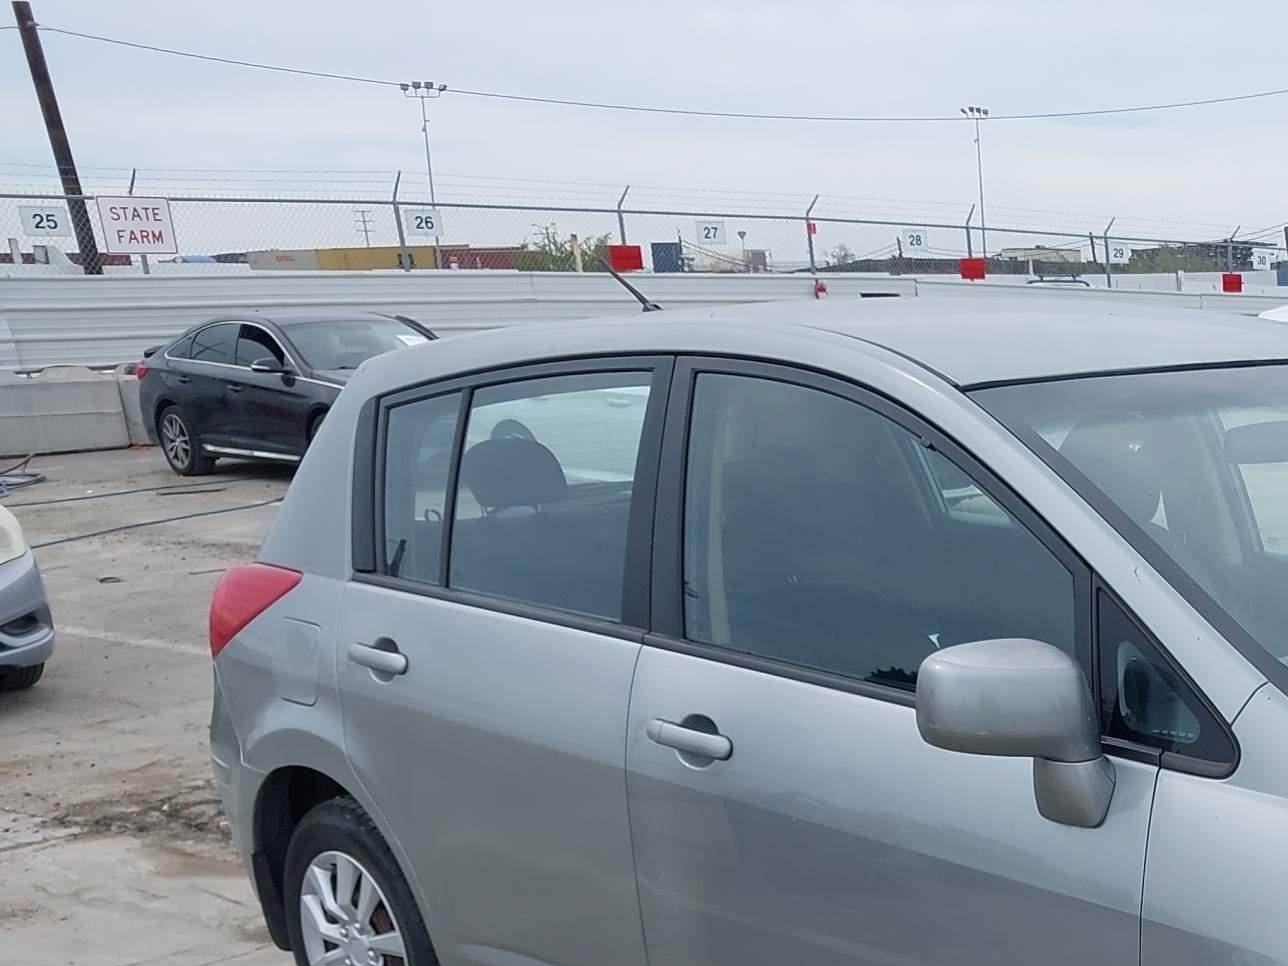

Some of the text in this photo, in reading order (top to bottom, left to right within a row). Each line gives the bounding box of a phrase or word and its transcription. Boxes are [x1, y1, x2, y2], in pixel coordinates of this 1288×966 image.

[109, 206, 163, 222] STATE
[32, 213, 58, 230] 25
[414, 215, 434, 230] 26
[117, 229, 165, 245] FARM
[703, 226, 719, 239] 27
[908, 234, 922, 247] 28
[1113, 247, 1124, 258] 29
[1257, 255, 1267, 266] 30
